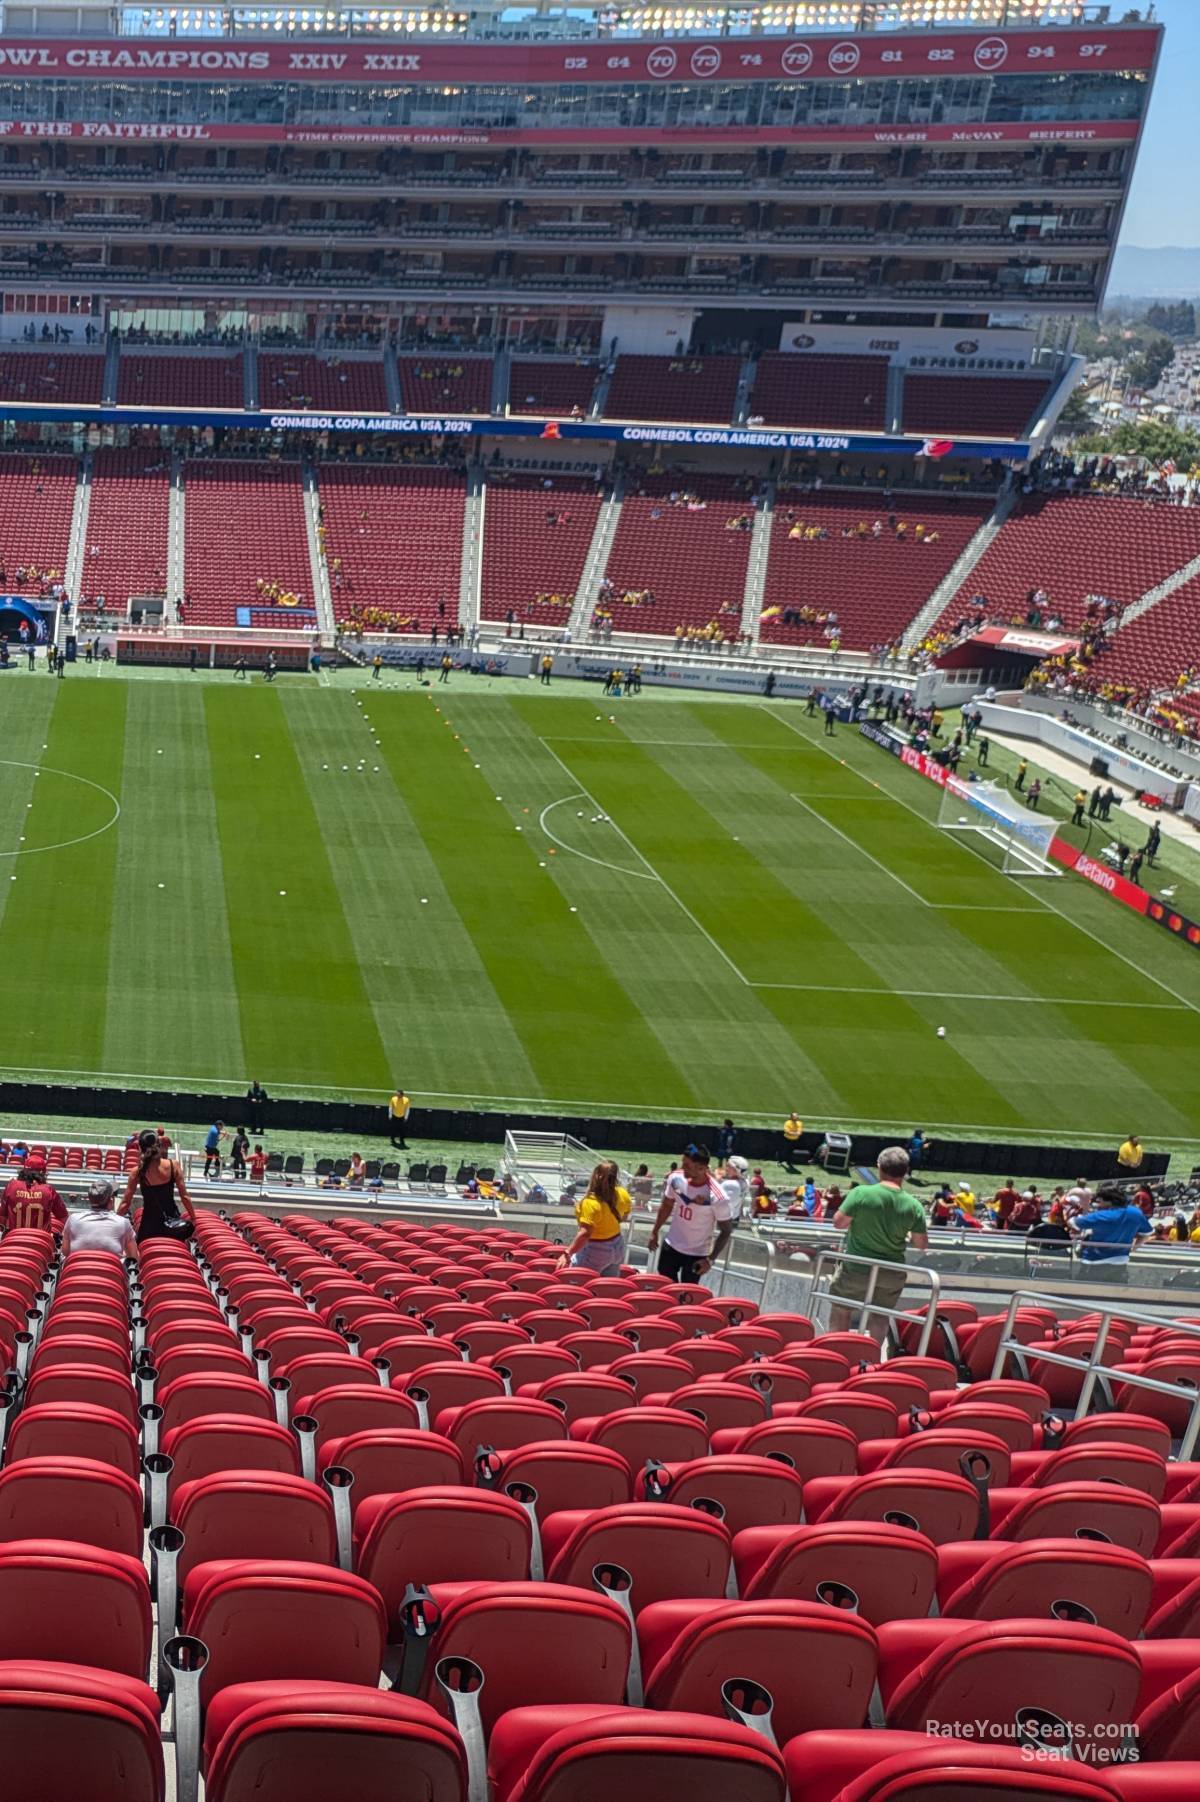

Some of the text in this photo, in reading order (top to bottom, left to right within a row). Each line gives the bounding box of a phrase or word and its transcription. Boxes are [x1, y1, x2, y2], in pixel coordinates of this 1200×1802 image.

[881, 50, 903, 62] 81
[927, 49, 955, 62] 82
[977, 47, 1004, 60] 87
[1027, 46, 1056, 59] 94
[1079, 44, 1107, 57] 97
[66, 48, 270, 69] CHAMPIONS
[289, 53, 421, 71] XXIV XXIX
[564, 56, 588, 70] 52
[607, 56, 631, 69] 64
[650, 55, 673, 68] 70
[693, 55, 718, 67] 73
[740, 53, 763, 66] 74
[785, 52, 809, 65] 79
[831, 52, 857, 64] 80
[20, 121, 72, 136] THE
[81, 123, 211, 138] FAITHFUL
[952, 131, 1003, 141] McVAY
[1028, 130, 1096, 139] SEIFERT
[332, 133, 410, 144] CONFERENCE
[413, 133, 489, 144] CHAMPIONS
[874, 132, 927, 142] WALSH
[271, 416, 472, 432] CONMEBOL COPA AMERICA USA 2024
[623, 428, 849, 449] CONMEBOL COPA AMERICA USA 2024
[902, 745, 921, 770] TCL
[924, 758, 945, 784] TCL
[1074, 854, 1116, 891] Betano
[13, 1202, 44, 1229] 10
[678, 1207, 693, 1221] 10
